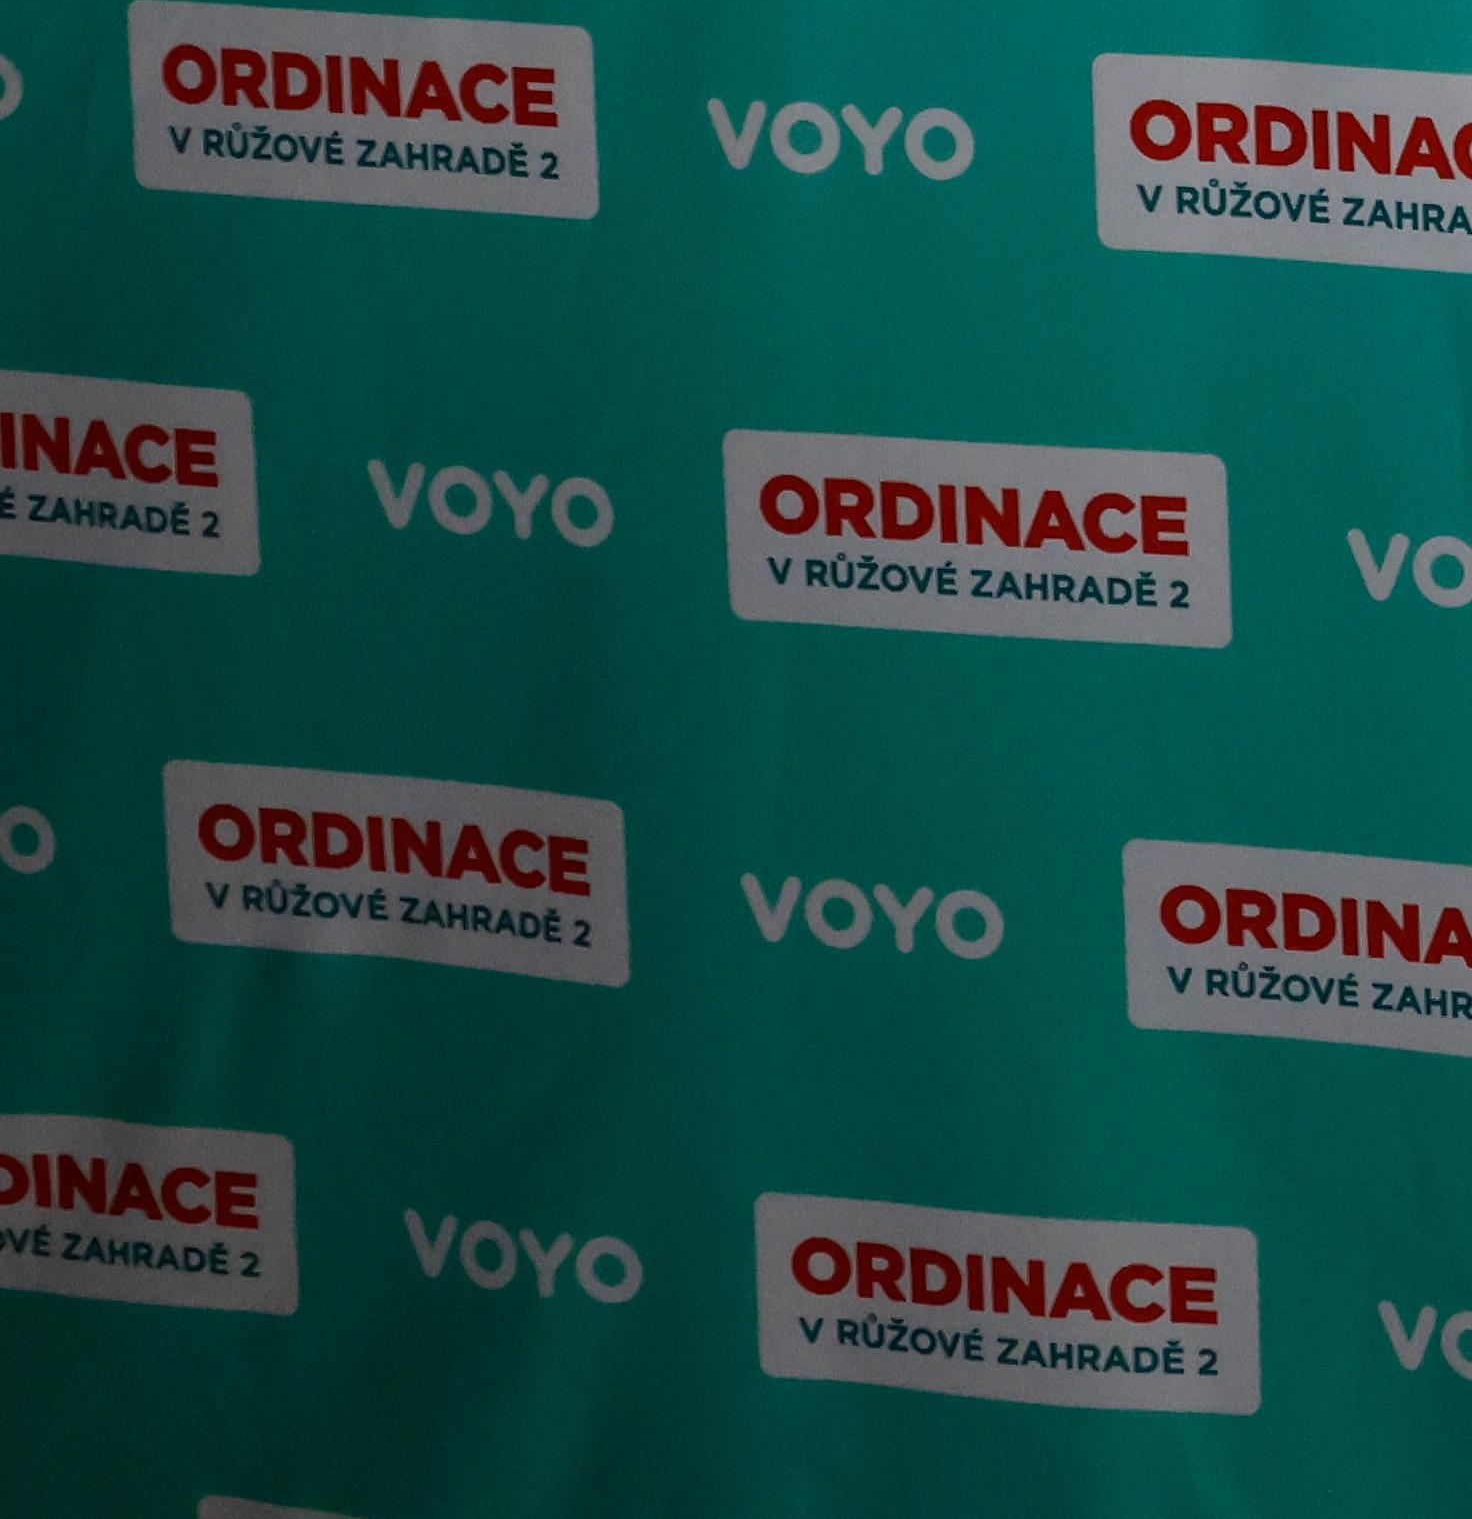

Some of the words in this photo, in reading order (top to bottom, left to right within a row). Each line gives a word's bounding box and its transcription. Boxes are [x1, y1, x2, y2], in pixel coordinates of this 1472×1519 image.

[163, 45, 558, 127] ORDINACE
[708, 98, 975, 181] VOYO
[1136, 182, 1164, 214] V
[1175, 177, 1331, 225] RŮŽOVÉ
[368, 460, 614, 547] VOYO
[760, 475, 1188, 555] ORDINACE
[199, 804, 590, 896] ORDINACE
[741, 873, 1004, 959] VOYO
[1166, 964, 1194, 995] V
[1204, 960, 1360, 1009] RŮŽOVÉ
[404, 1210, 643, 1303] VOYO
[792, 1238, 1217, 1324] ORDINACE
